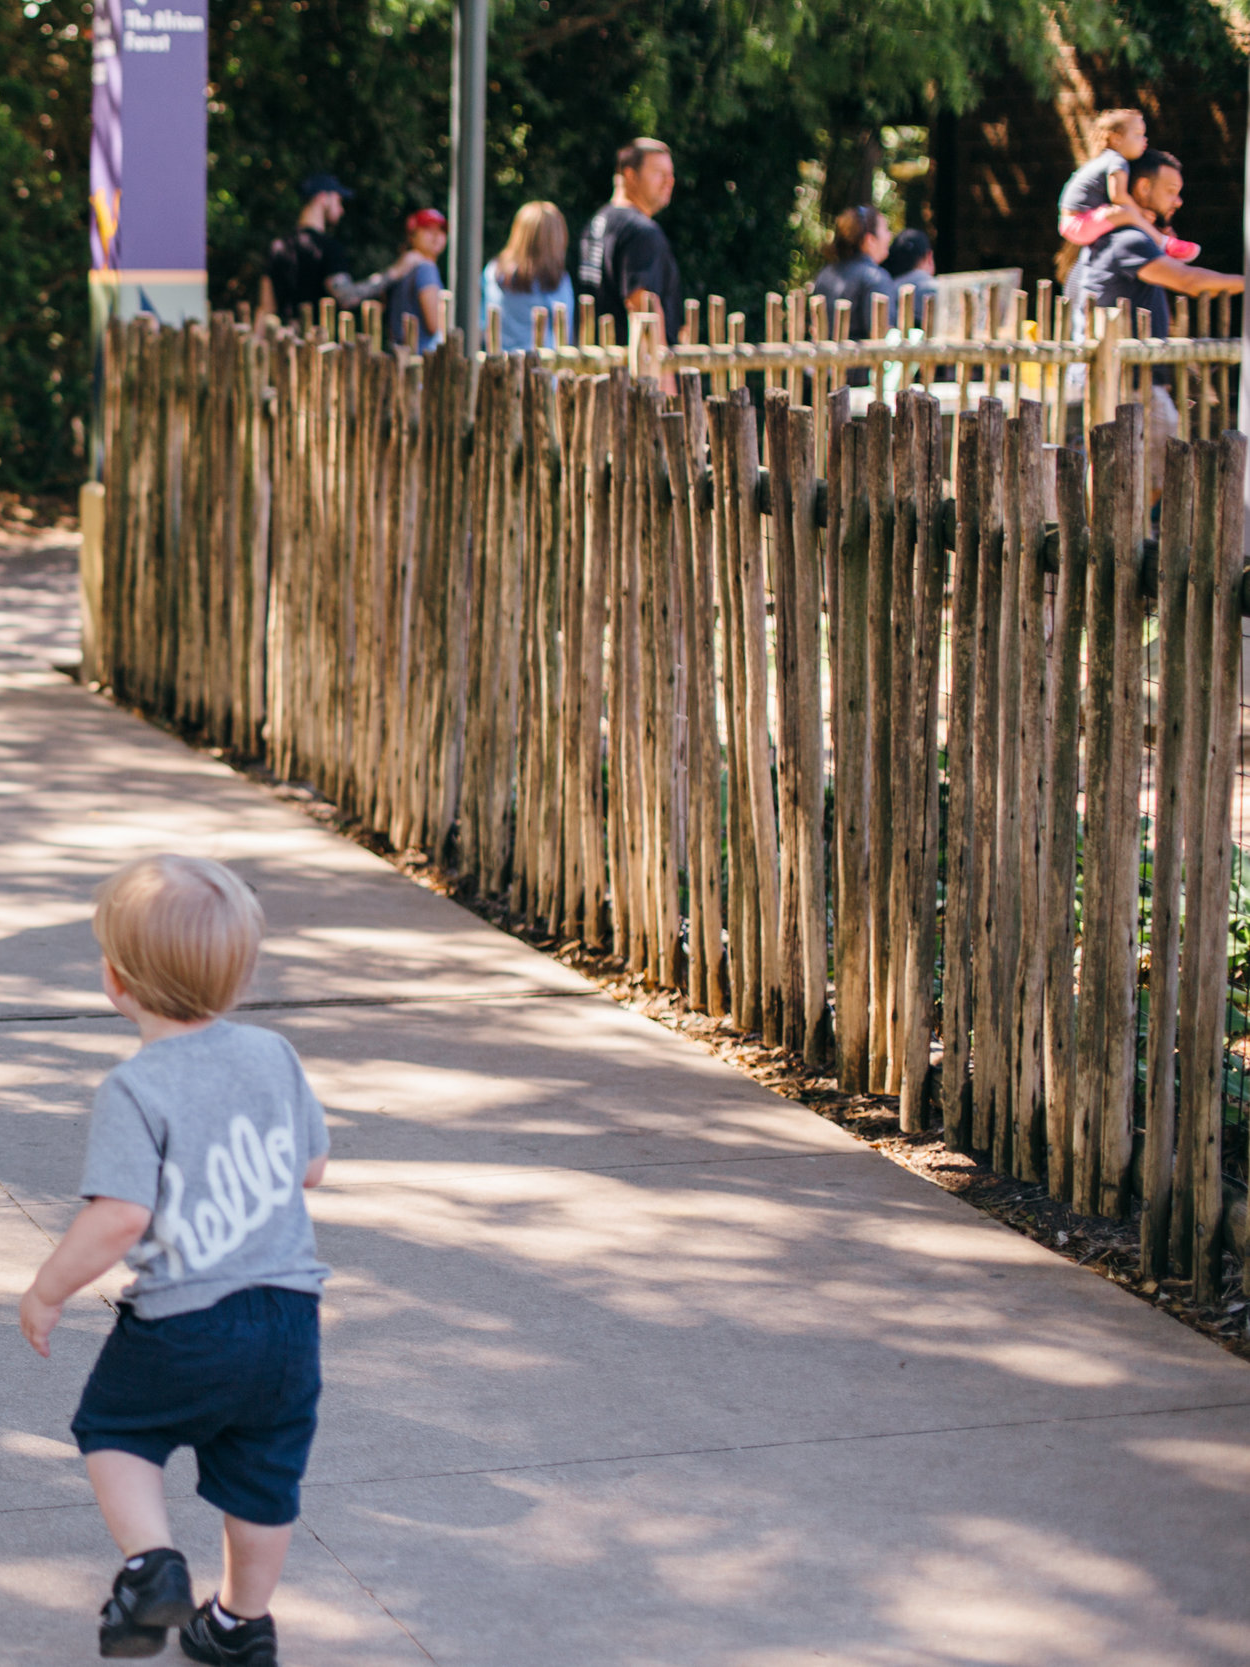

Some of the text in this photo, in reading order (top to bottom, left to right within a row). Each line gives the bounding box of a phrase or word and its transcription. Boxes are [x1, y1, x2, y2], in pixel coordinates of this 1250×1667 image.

[125, 8, 205, 32] The African
[124, 30, 171, 53] Forest
[144, 1101, 297, 1280] hello
